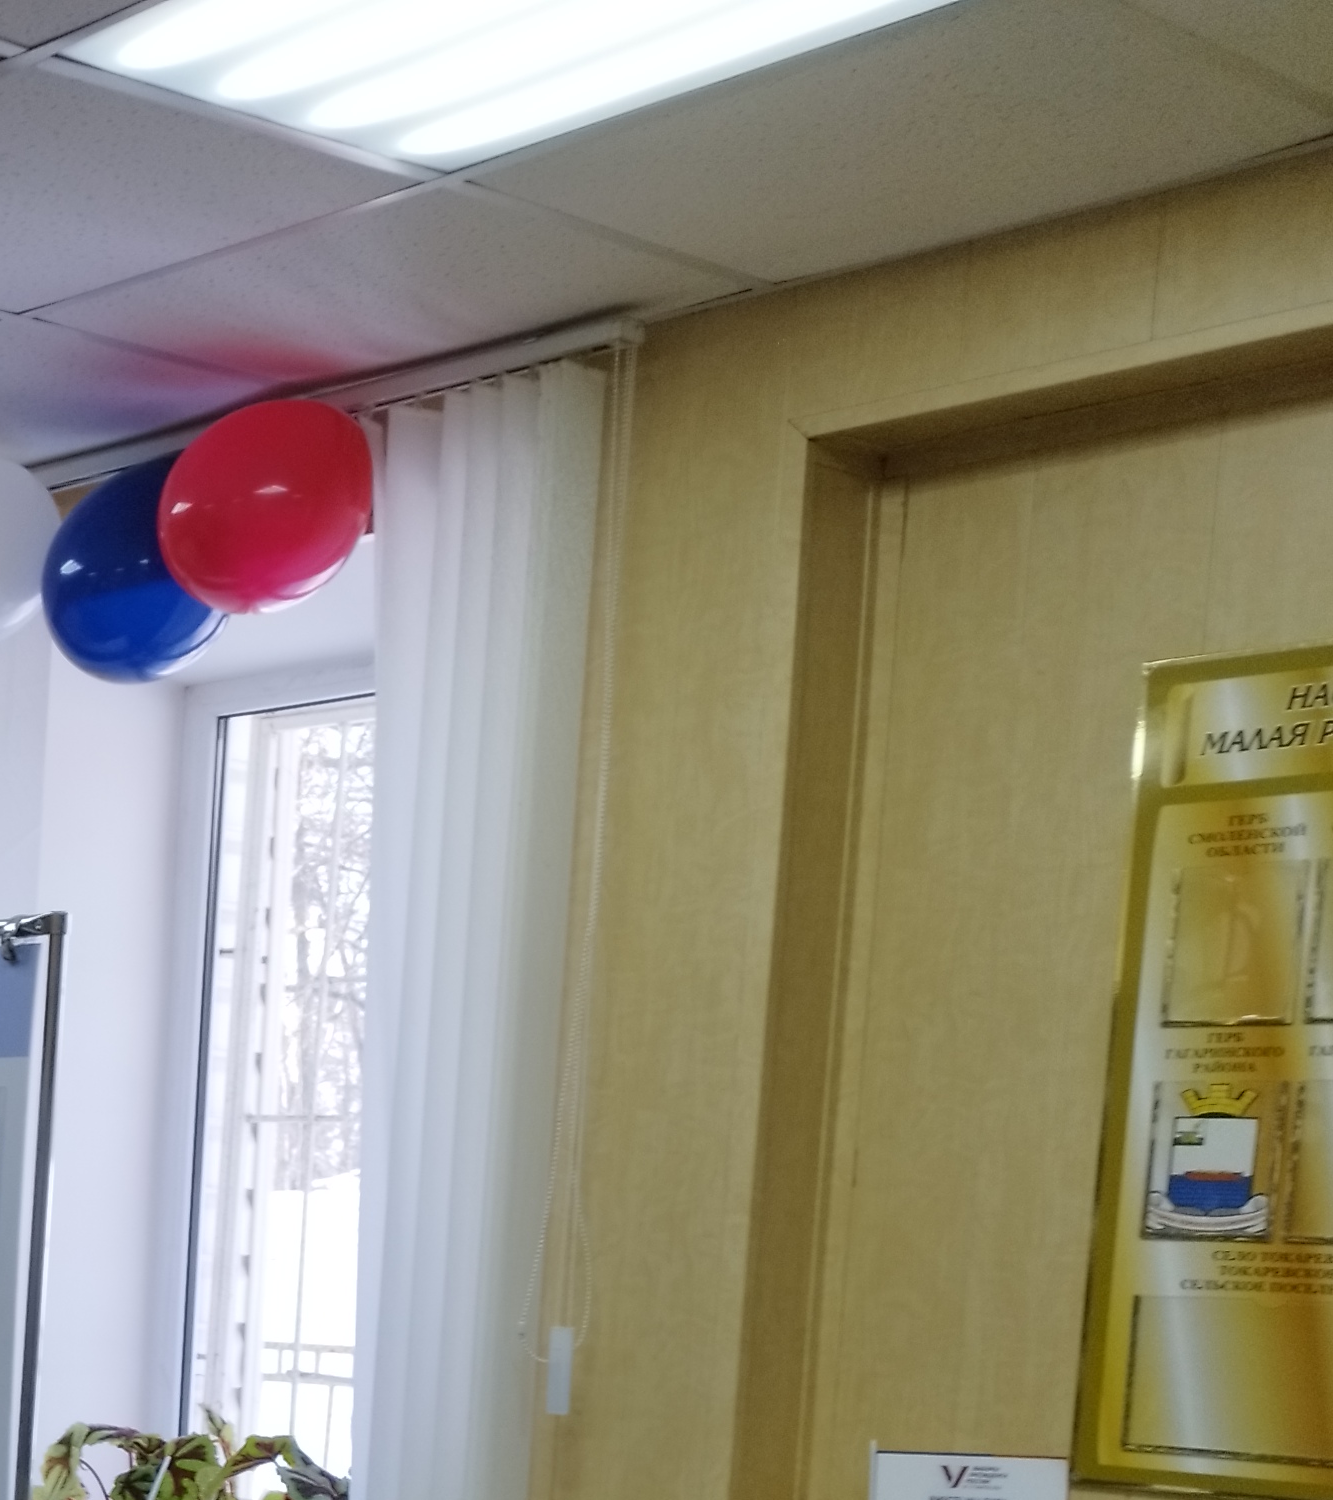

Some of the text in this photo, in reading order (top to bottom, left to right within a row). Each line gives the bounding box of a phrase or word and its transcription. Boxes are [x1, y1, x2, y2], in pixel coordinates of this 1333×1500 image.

[1287, 683, 1333, 710] НА
[1200, 721, 1311, 756] МАЛАЯ
[1228, 813, 1268, 827] ГЕРБ
